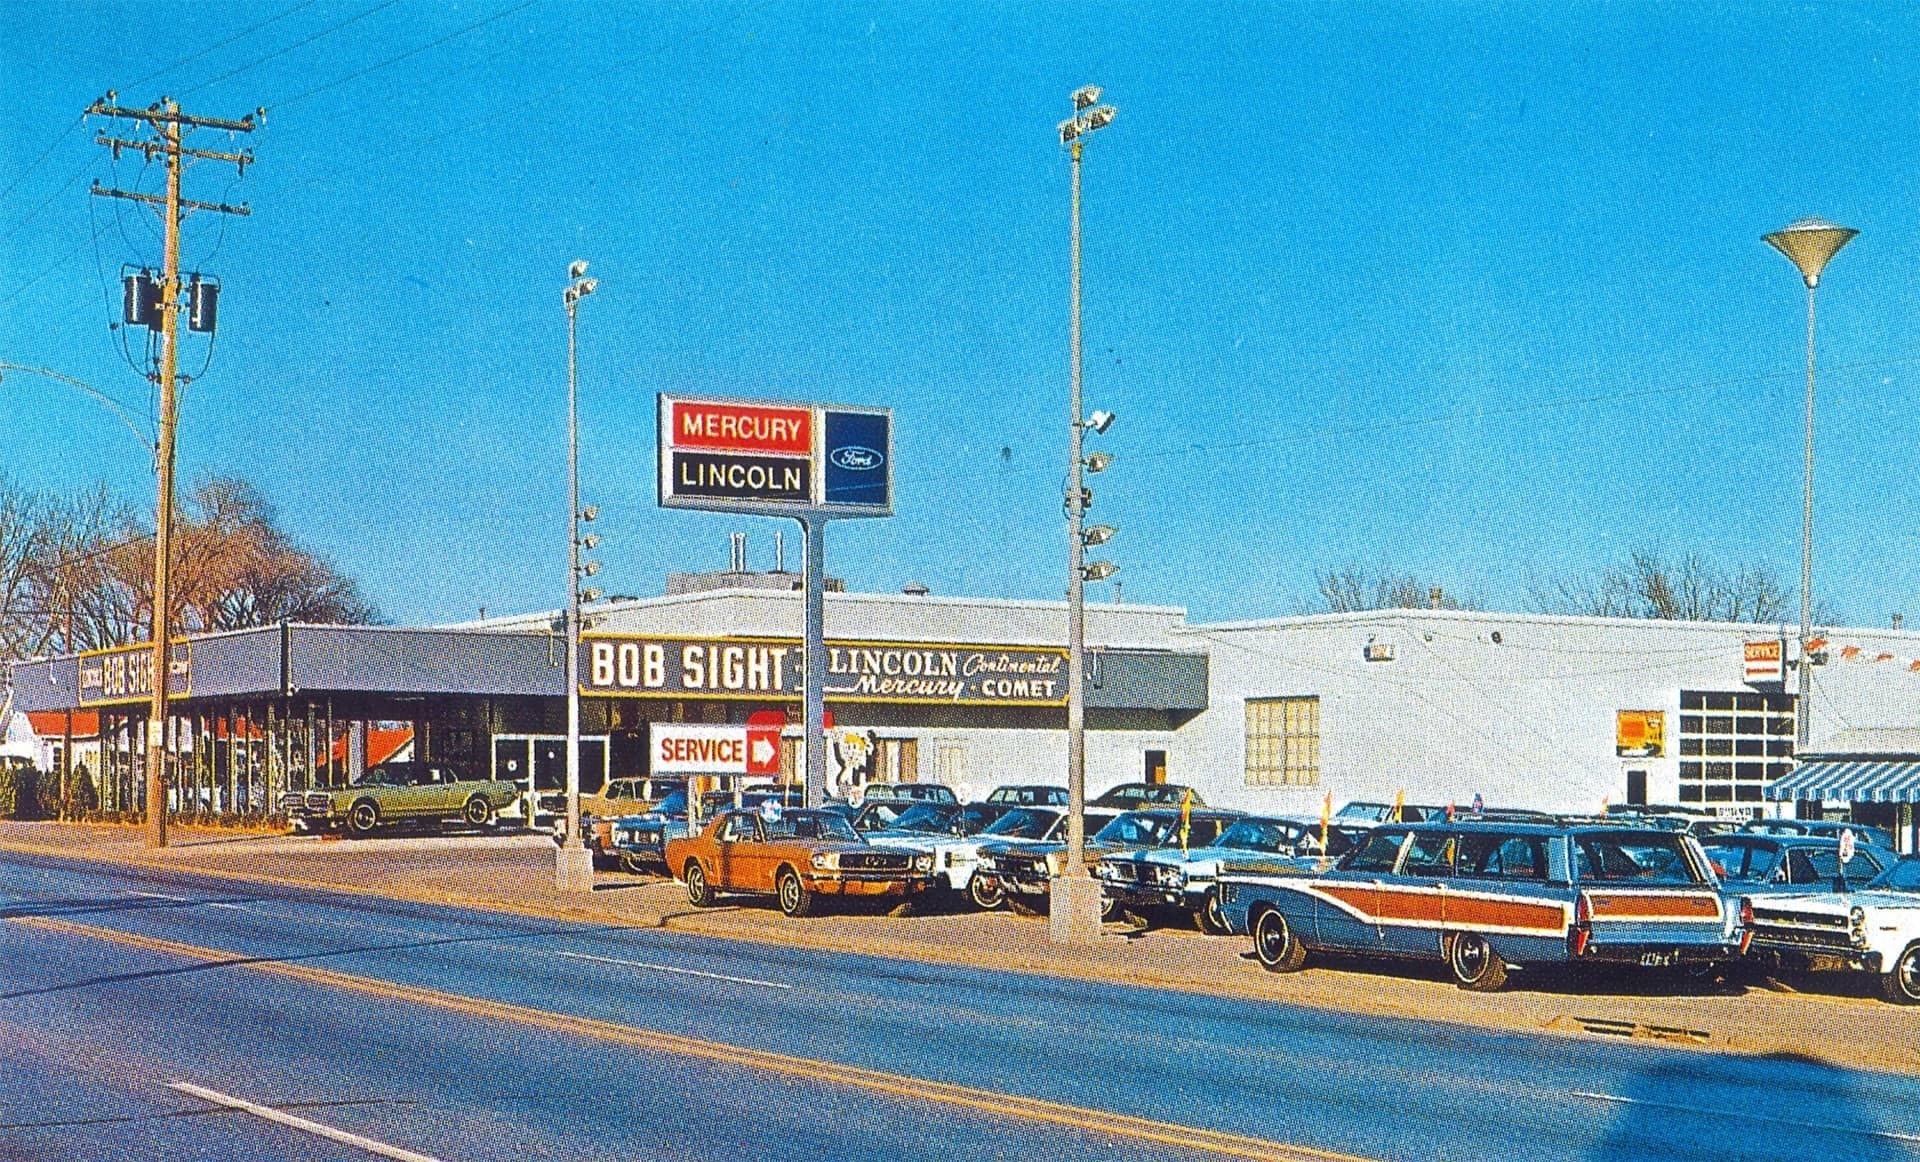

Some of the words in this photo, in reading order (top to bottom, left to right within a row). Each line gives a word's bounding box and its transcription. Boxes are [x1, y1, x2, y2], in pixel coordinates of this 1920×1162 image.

[683, 412, 801, 442] MERCURY
[841, 450, 873, 466] Ford
[682, 462, 801, 490] LINCOLN
[104, 655, 125, 695] BOB
[128, 652, 155, 693] SIGH
[591, 643, 665, 688] BOB
[682, 646, 788, 691] SIGHT
[829, 649, 957, 677] LINCOLN
[962, 653, 1060, 677] Continental
[853, 674, 965, 700] Mercury
[981, 679, 1058, 698] COMET
[661, 737, 744, 763] SERVICE
